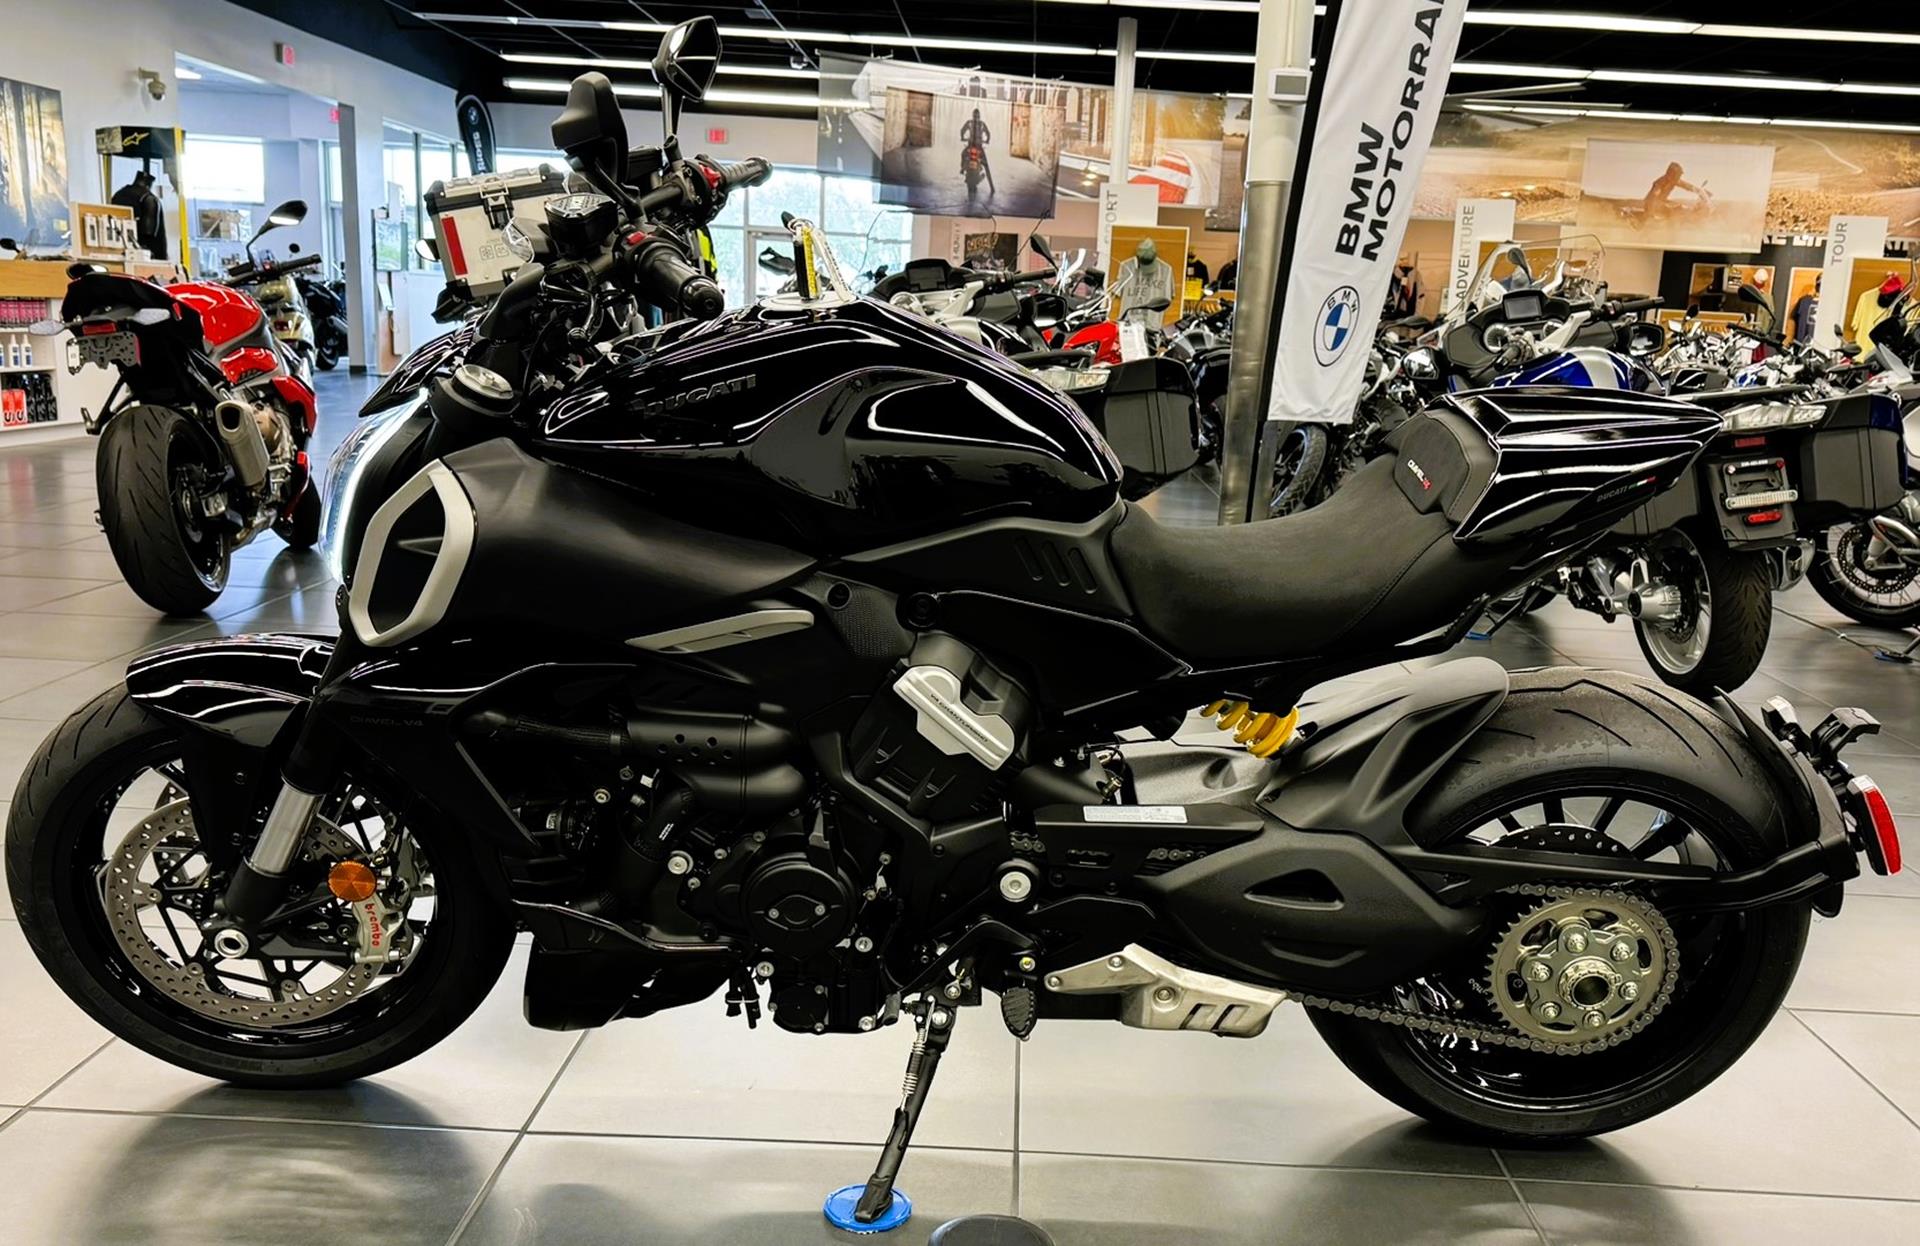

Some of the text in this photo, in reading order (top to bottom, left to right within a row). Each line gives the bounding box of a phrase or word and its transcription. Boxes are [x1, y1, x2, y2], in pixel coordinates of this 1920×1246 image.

[1361, 0, 1445, 262] MOTORRA
[1335, 122, 1384, 256] BMW
[1455, 205, 1475, 301] ADVENTURE
[1831, 222, 1848, 266] TOUR
[1127, 286, 1148, 297] LIFE
[644, 374, 757, 418] DUCATI
[1597, 485, 1628, 503] DUCATI
[364, 903, 383, 947] brembo
